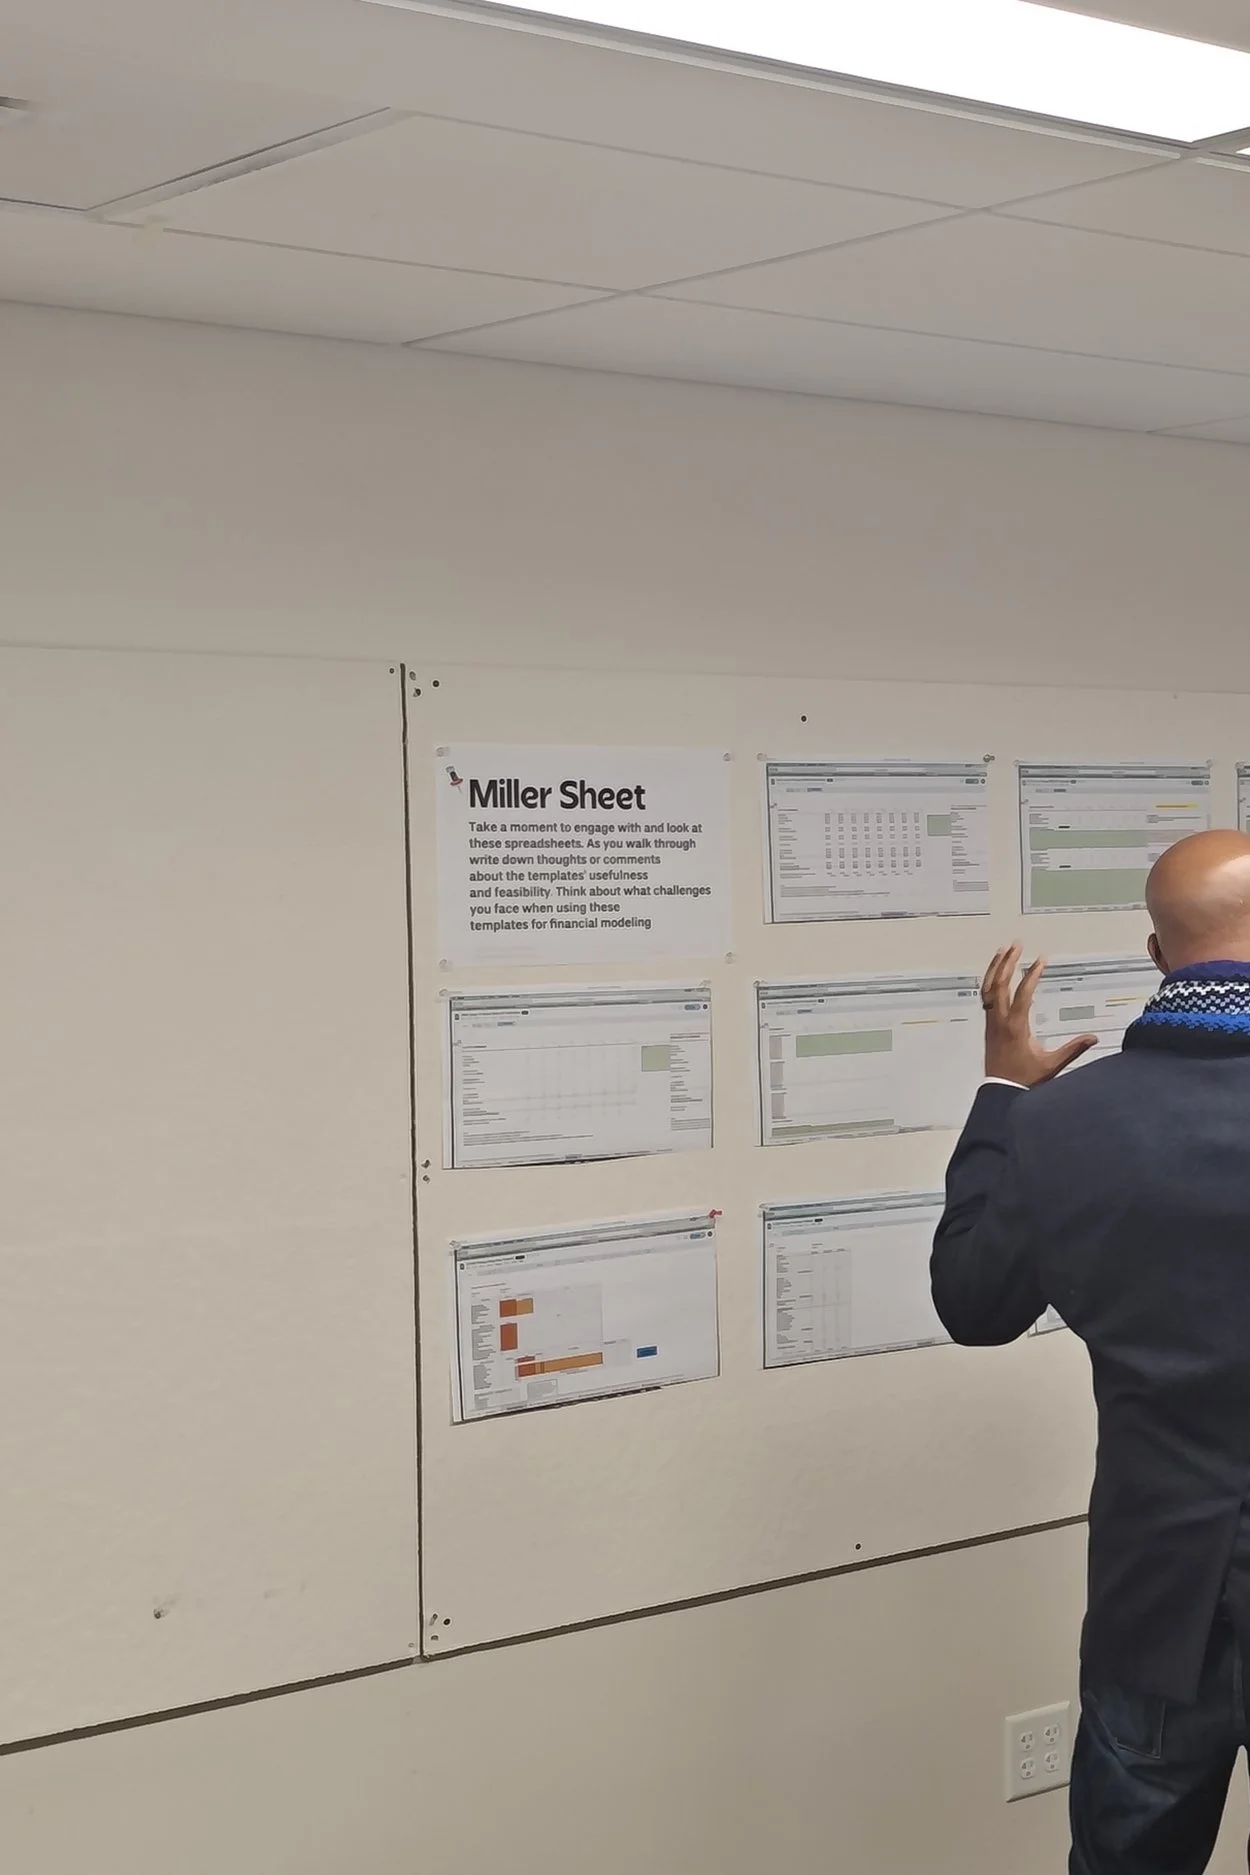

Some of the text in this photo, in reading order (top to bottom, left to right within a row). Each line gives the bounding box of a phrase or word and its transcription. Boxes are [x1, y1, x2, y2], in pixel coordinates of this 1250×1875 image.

[469, 778, 646, 810] Miller Sheet
[468, 821, 703, 836] Take a moment to engage with and look at
[469, 838, 696, 851] these spreadsheets. As you walk through
[469, 854, 661, 867] write down thoughts or comments
[469, 870, 503, 881] about
[506, 870, 525, 881] the
[589, 869, 648, 880] usefulness
[469, 887, 491, 898] and
[556, 886, 586, 897] Think
[589, 886, 621, 896] about
[623, 885, 651, 896] what
[653, 885, 711, 898] challenges
[470, 901, 621, 917] you face when using these
[470, 916, 652, 932] templates for financial modeling
